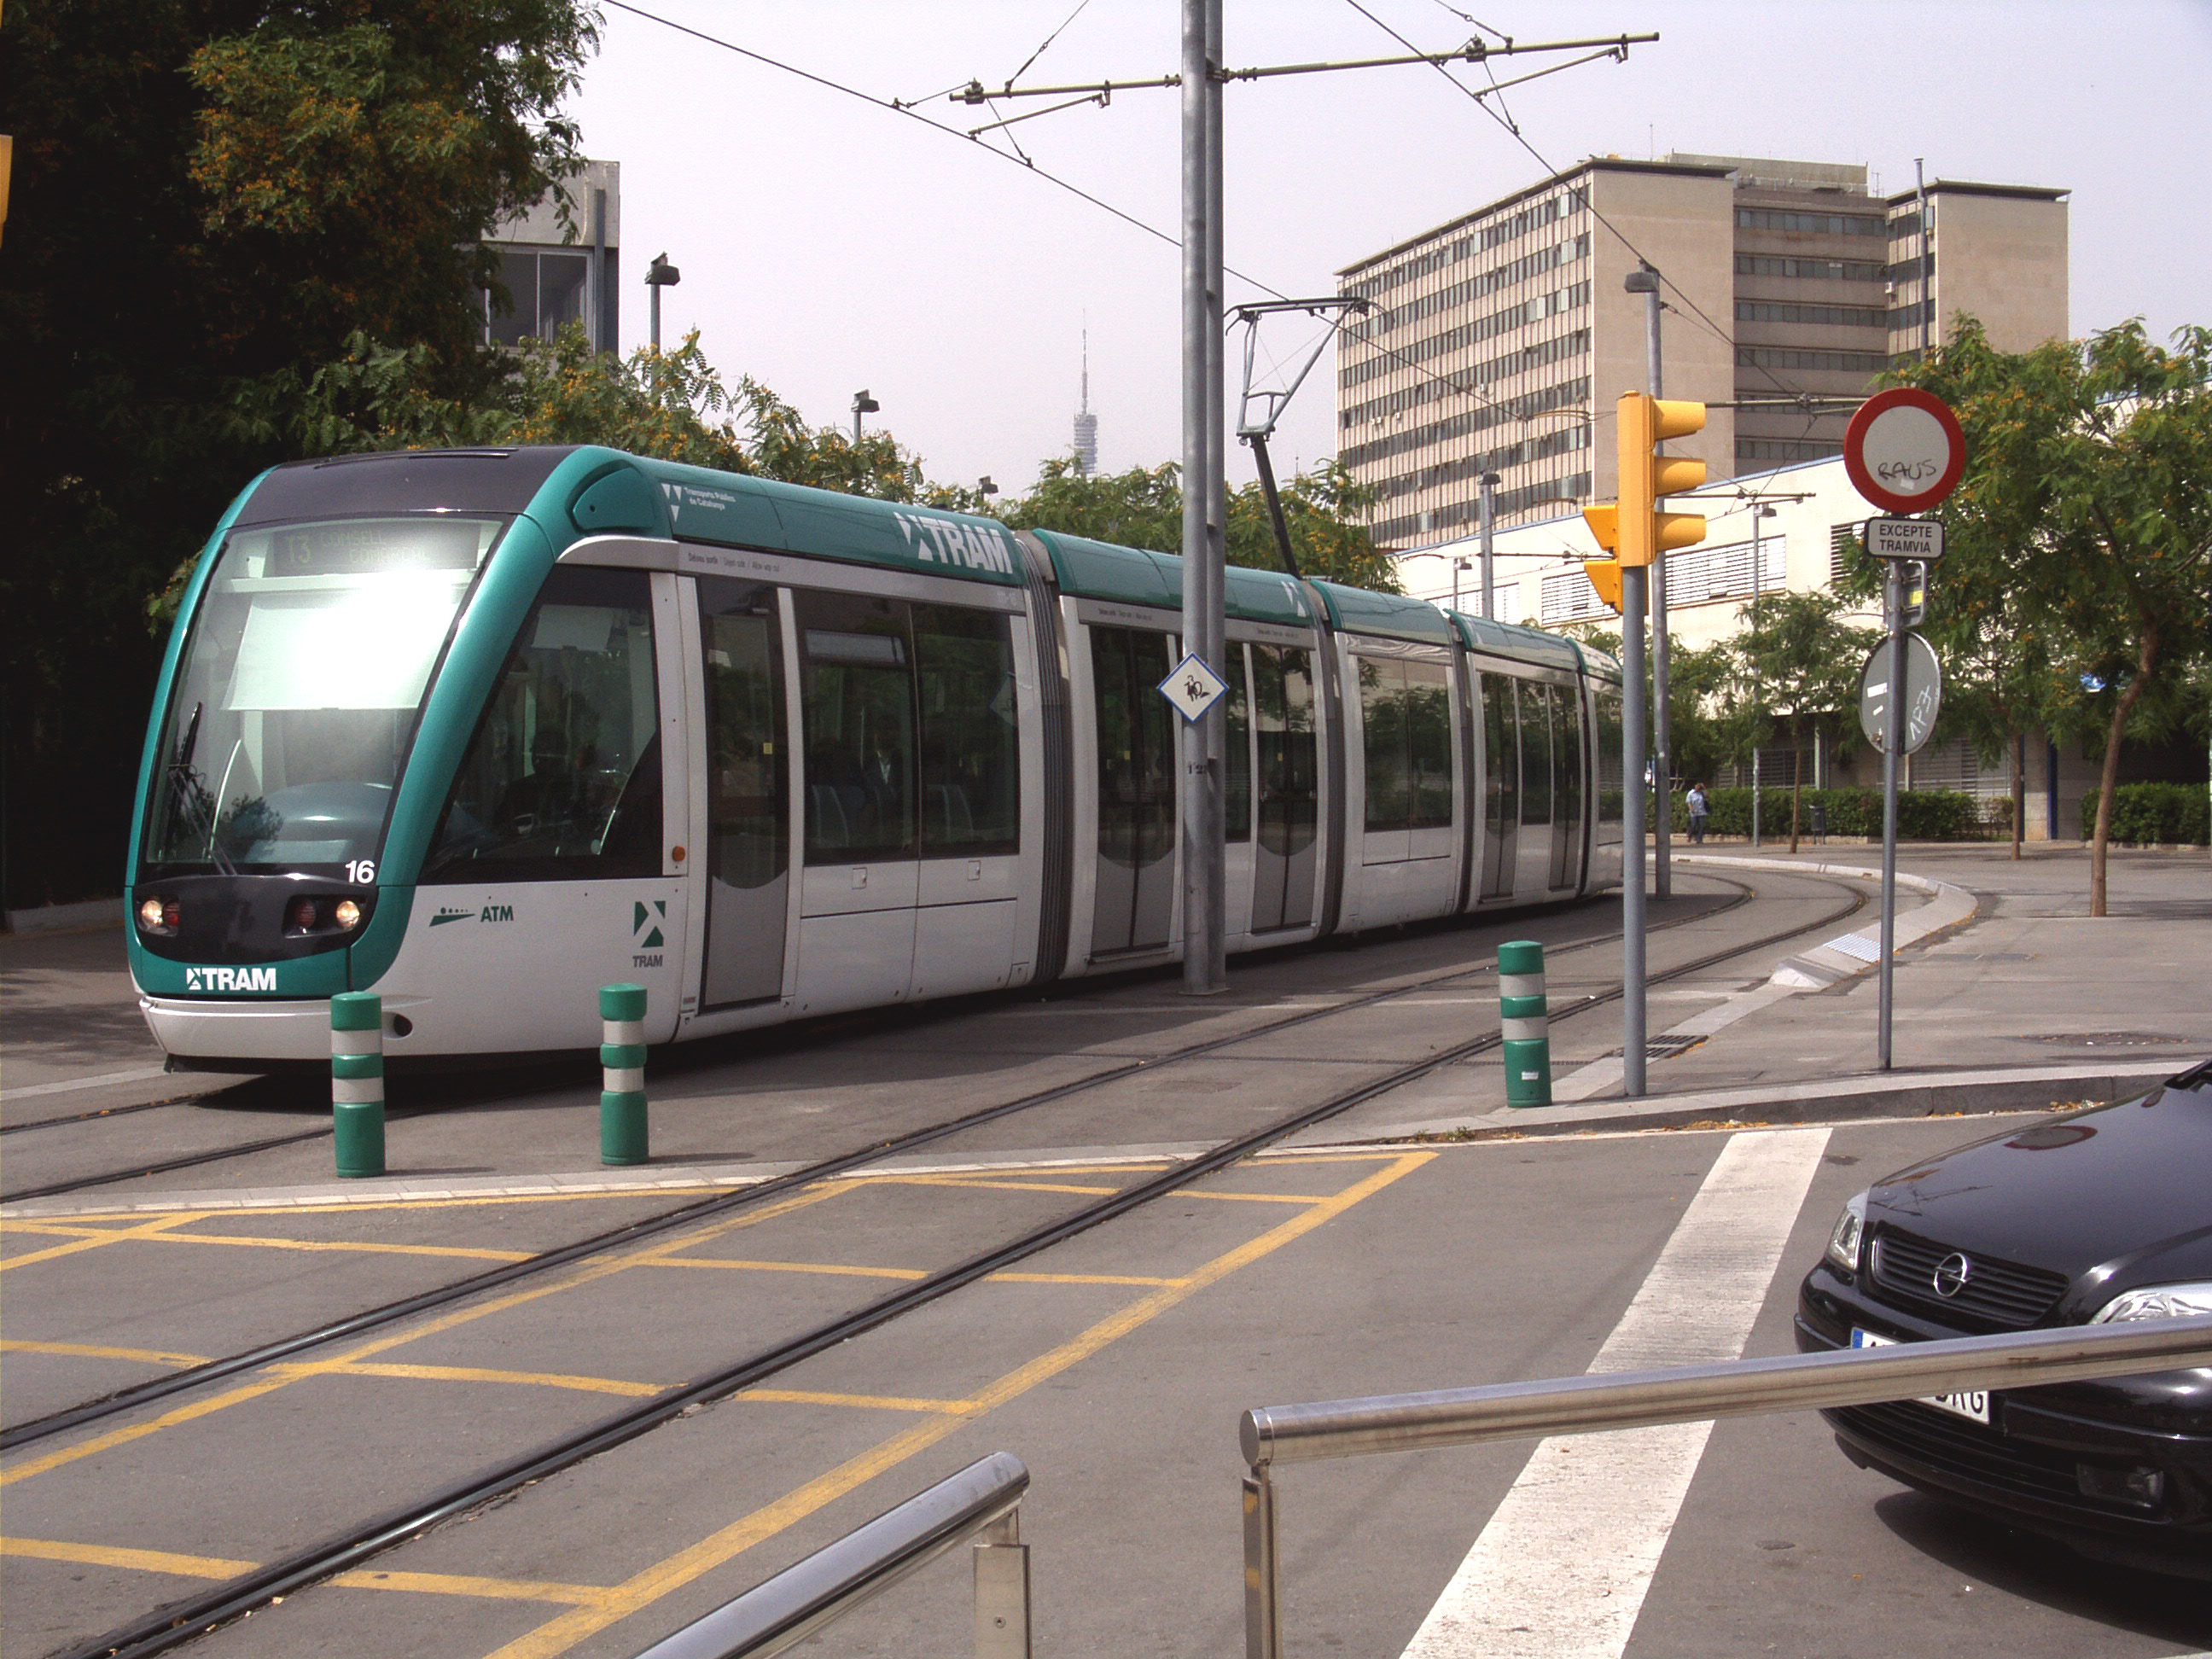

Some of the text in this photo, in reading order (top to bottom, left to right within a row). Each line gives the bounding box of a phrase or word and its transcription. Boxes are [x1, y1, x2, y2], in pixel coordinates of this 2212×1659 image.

[1877, 459, 1936, 480] RAUS
[1879, 524, 1933, 538] EXCEPTE
[917, 516, 1014, 574] TRAM
[1879, 539, 1931, 553] TRAMVIA
[345, 859, 375, 884] 16
[480, 905, 514, 923] ATM
[632, 954, 664, 968] TRAM
[201, 968, 276, 991] TRAM
